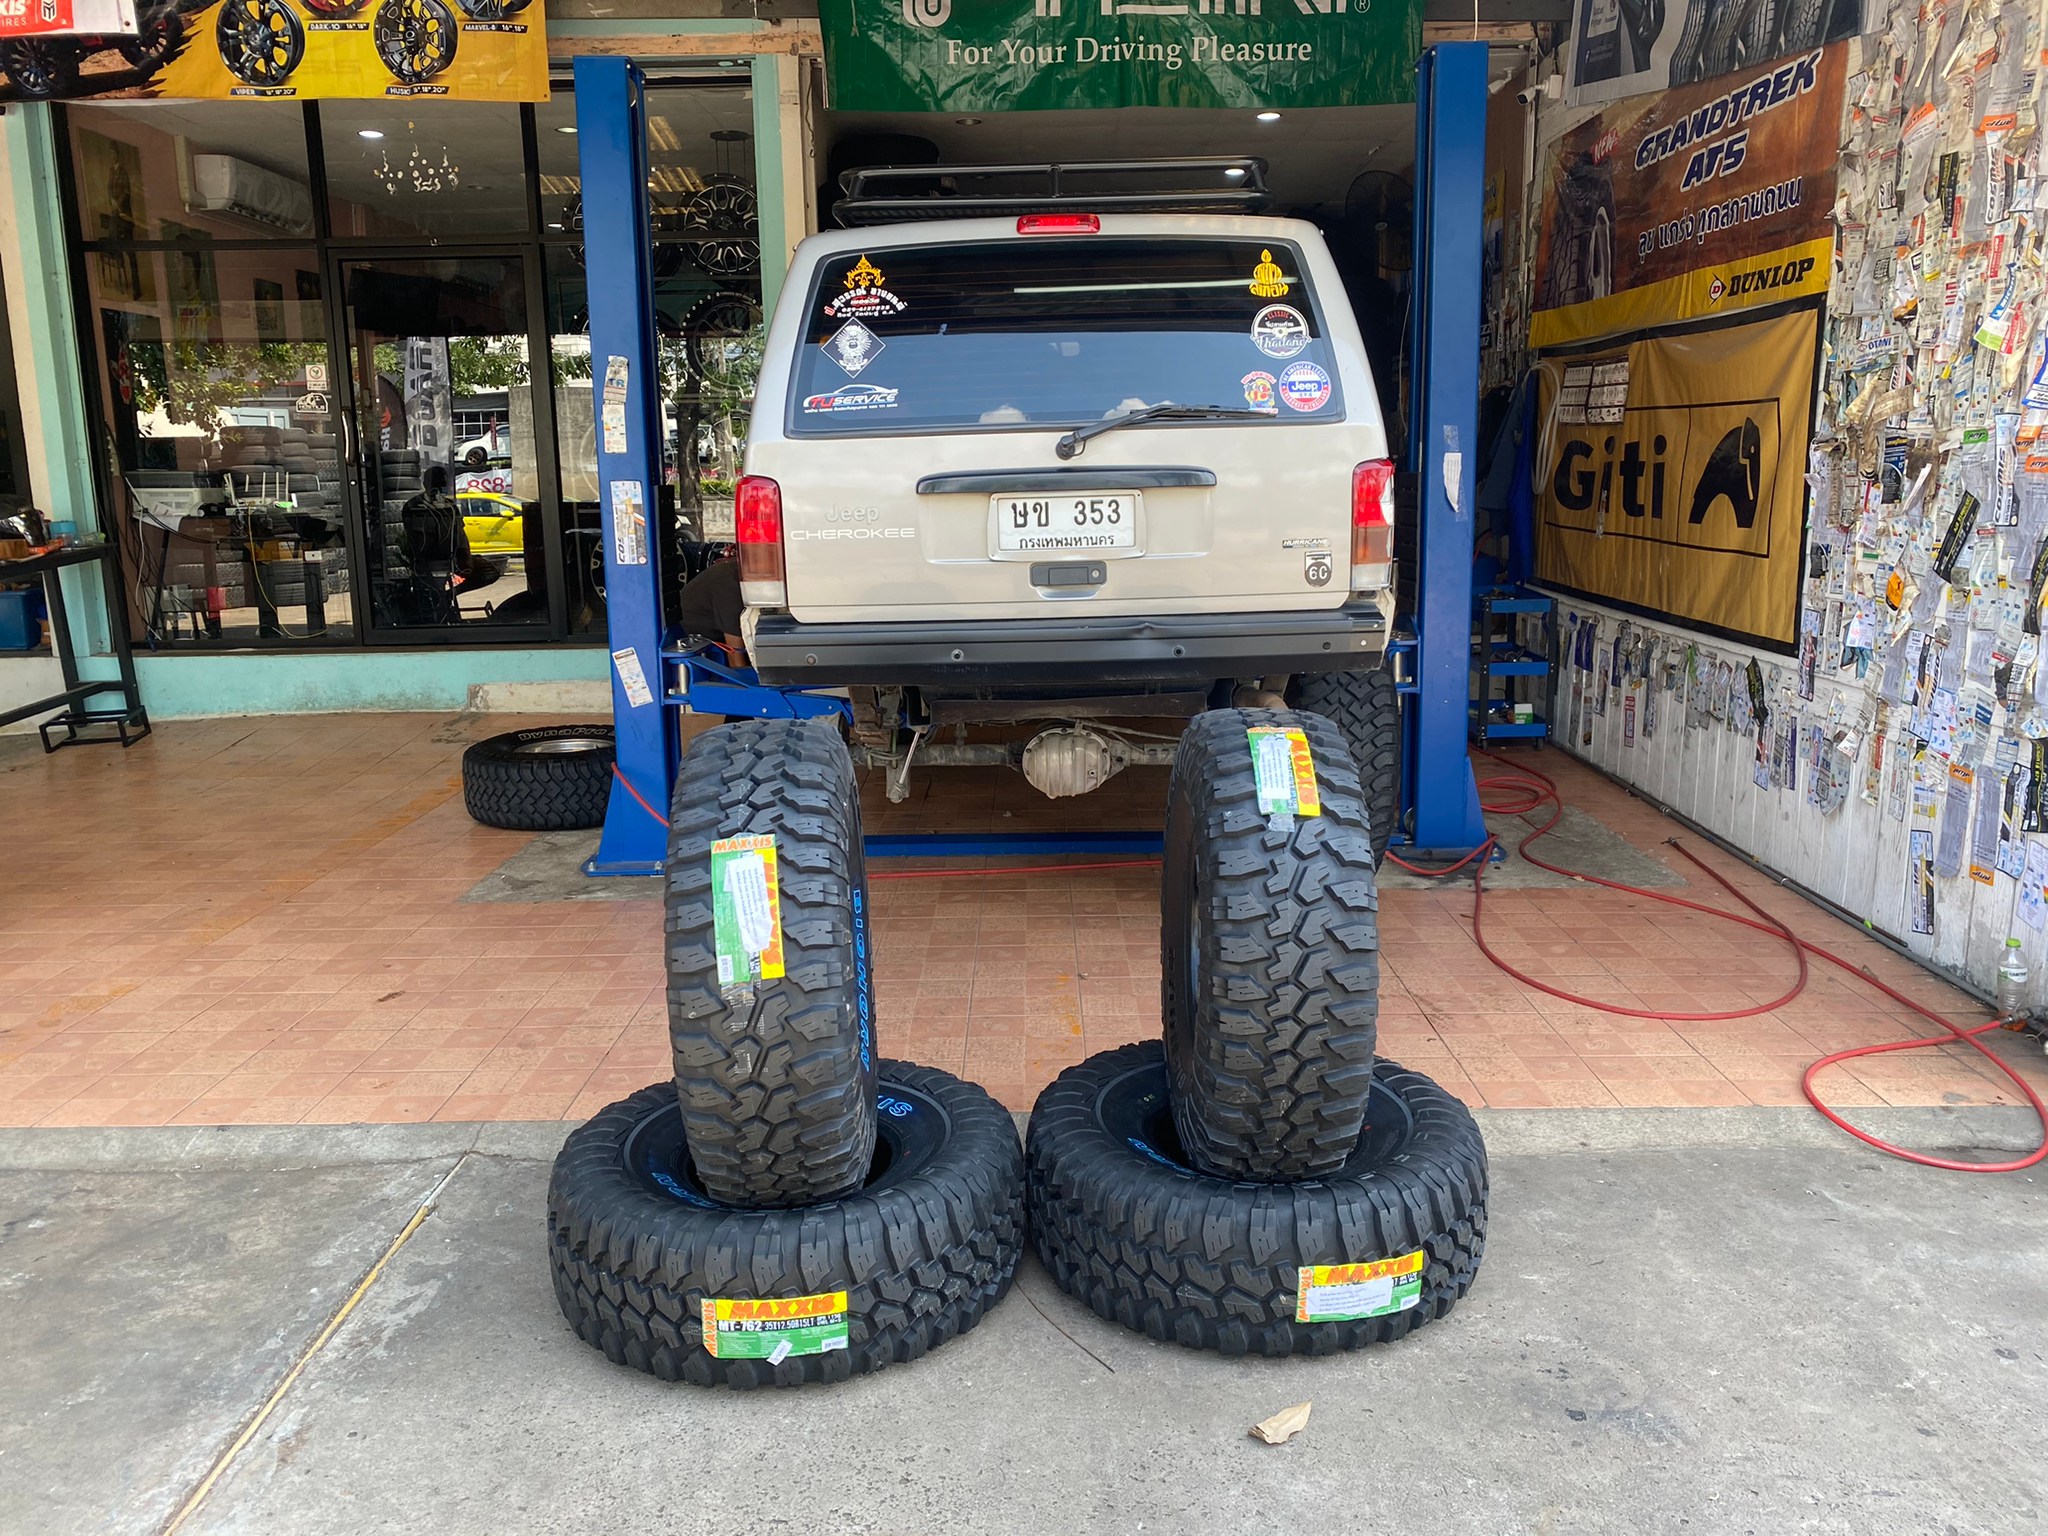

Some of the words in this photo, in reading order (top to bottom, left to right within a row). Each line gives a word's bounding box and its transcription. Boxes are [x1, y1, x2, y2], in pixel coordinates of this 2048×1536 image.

[947, 39, 993, 65] For
[1000, 38, 1067, 64] Your
[1075, 35, 1183, 70] Driving
[1191, 35, 1312, 62] Pleasure
[1635, 47, 1824, 170] GRANDTREK
[1659, 207, 1694, 248] แกร่ง
[1697, 176, 1802, 245] ทุกสภาพถนน
[1727, 257, 1815, 297] DUNLOP
[1257, 332, 1308, 349] Thailand
[1867, 337, 1892, 350] OTANI
[1291, 381, 1318, 392] Jeep
[1553, 434, 1668, 520] Giti
[825, 503, 880, 525] Jeep
[1010, 501, 1050, 529] ษข
[1073, 498, 1121, 526] 353
[790, 527, 916, 541] CHEROKEE
[1019, 534, 1115, 549] กรงเทพมหานคร
[713, 836, 773, 853] MAXXIS
[852, 888, 870, 1073] BIGHORN
[1326, 1254, 1415, 1284] MAXXIS
[729, 1294, 836, 1320] MAXXIS
[1298, 1267, 1314, 1321] MAXXIS
[703, 1301, 717, 1357] MAXXIS
[718, 1320, 763, 1332] MT-762
